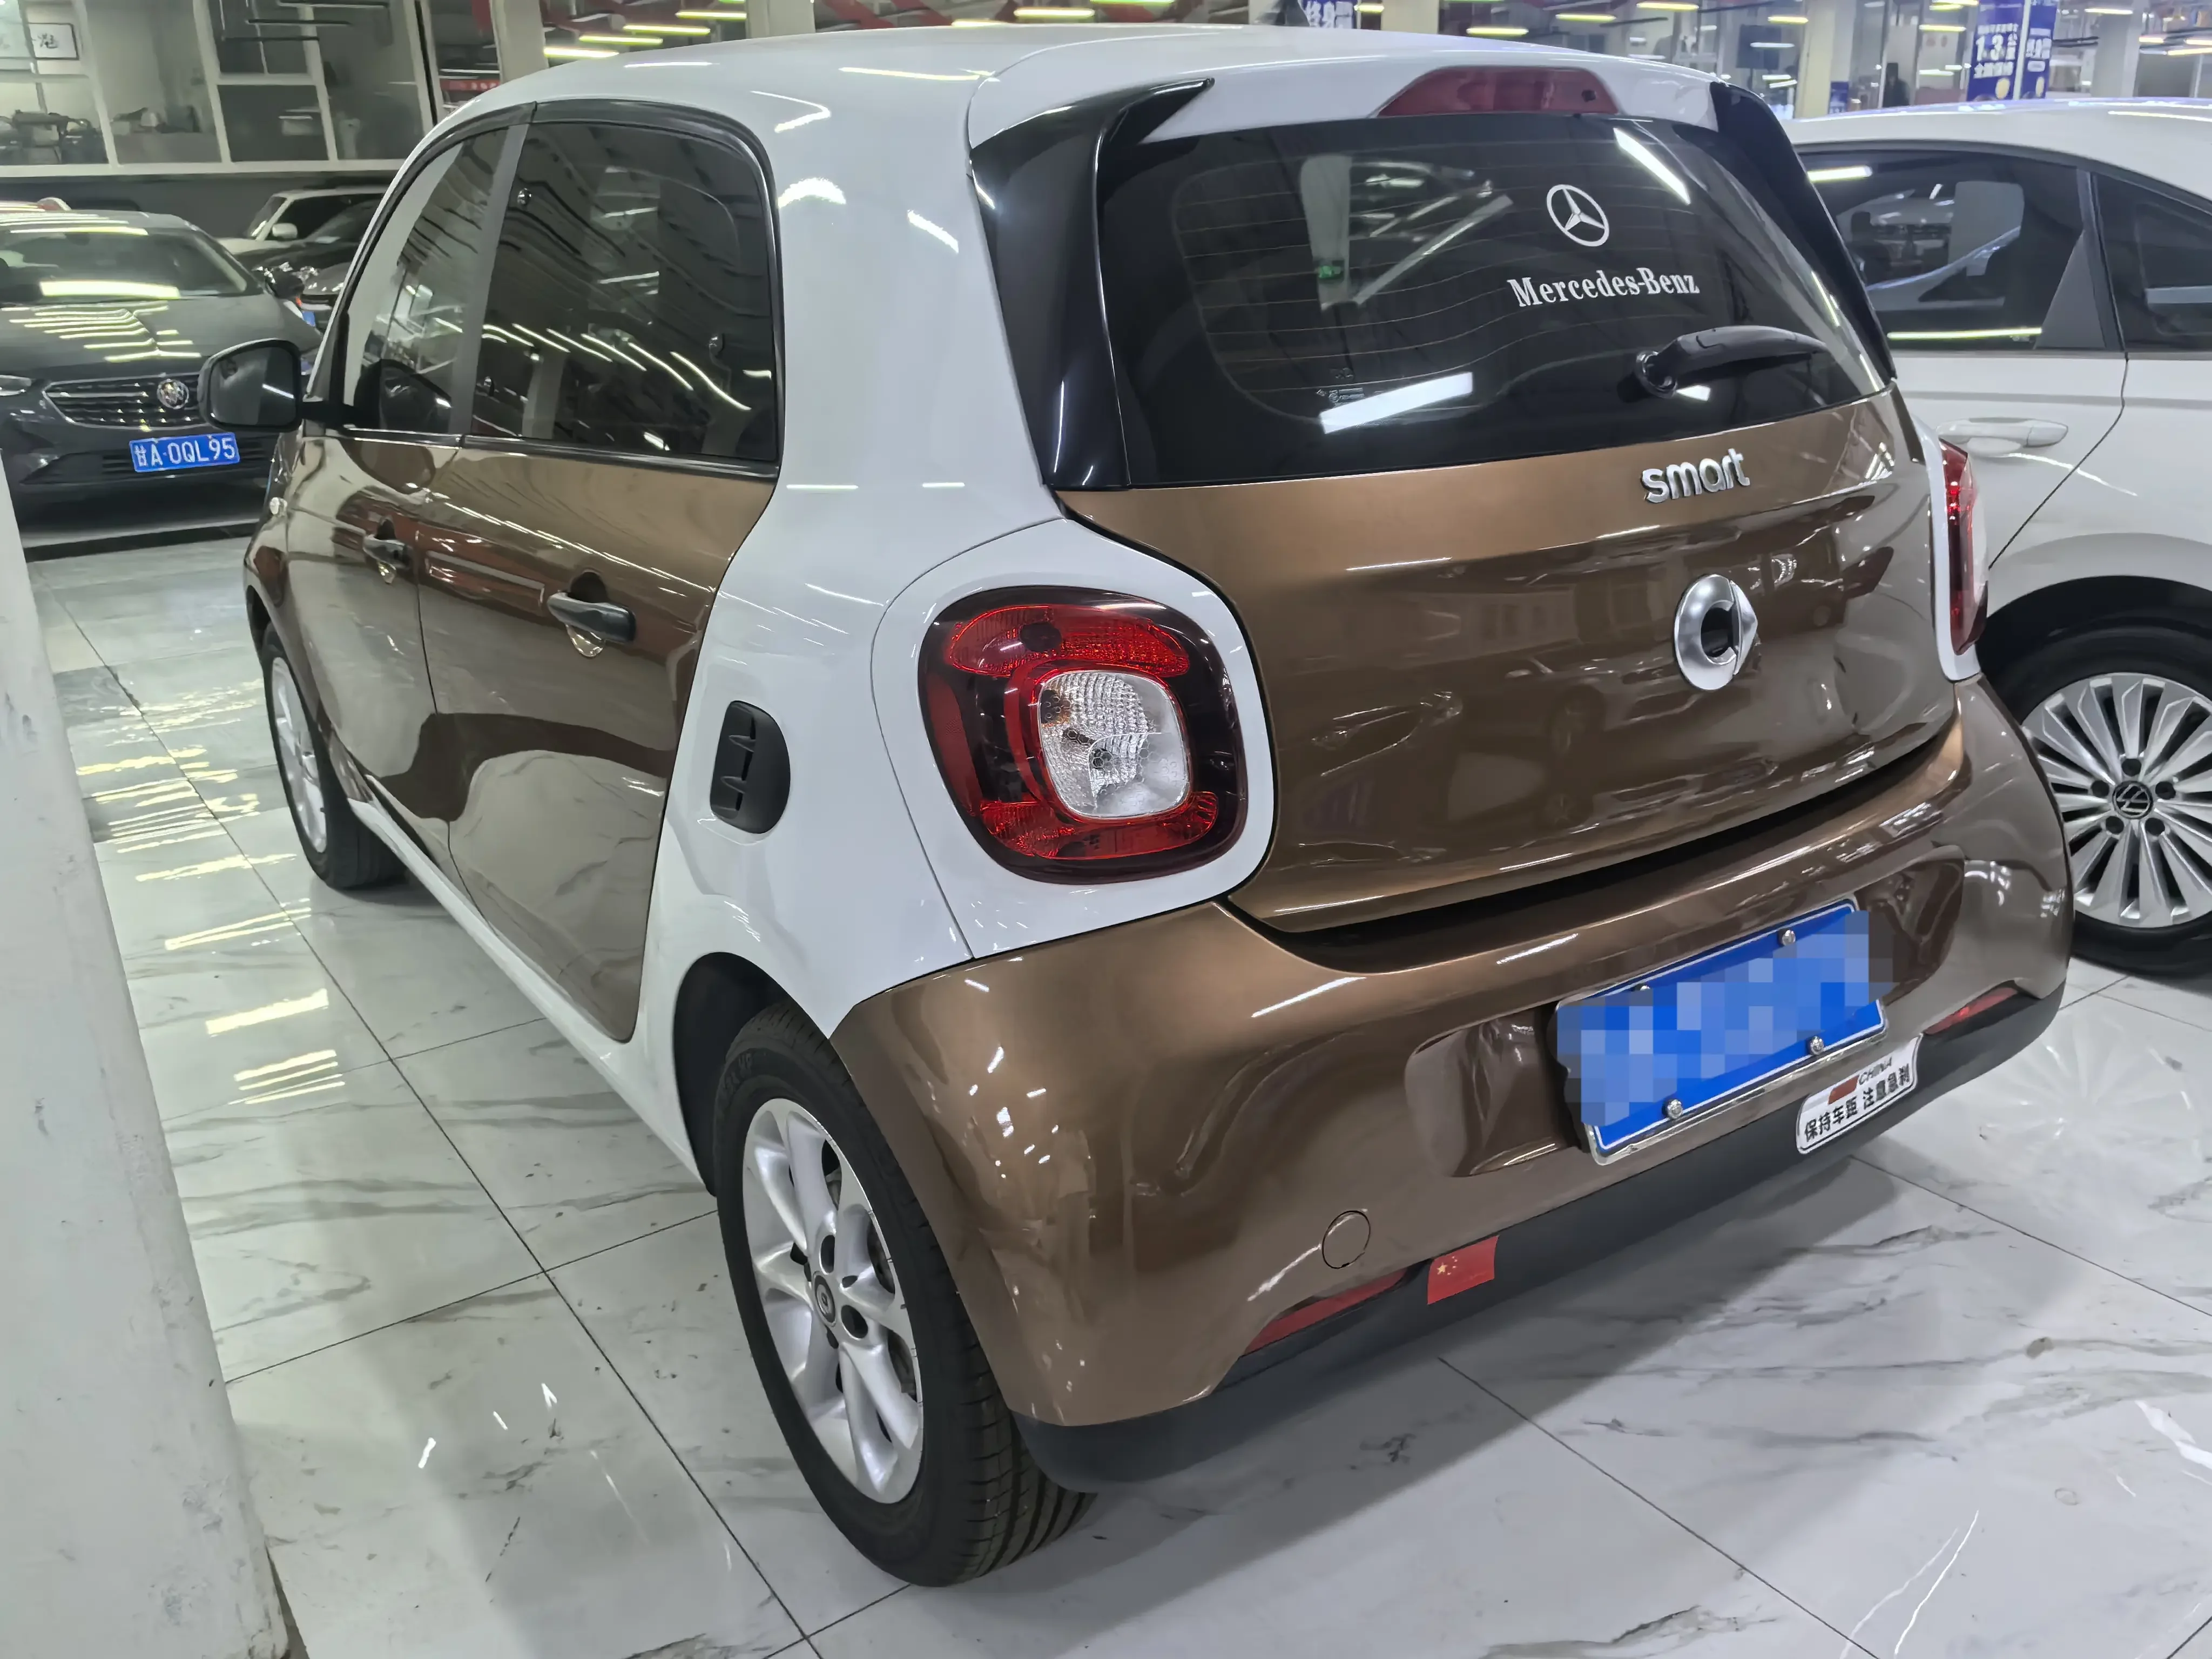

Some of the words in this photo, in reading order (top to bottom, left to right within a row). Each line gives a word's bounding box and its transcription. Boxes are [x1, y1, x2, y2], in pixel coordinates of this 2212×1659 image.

[1507, 267, 1700, 307] Mercedes-Benz
[1642, 448, 1751, 503] smart
[1804, 1096, 1858, 1142] 保持车距
